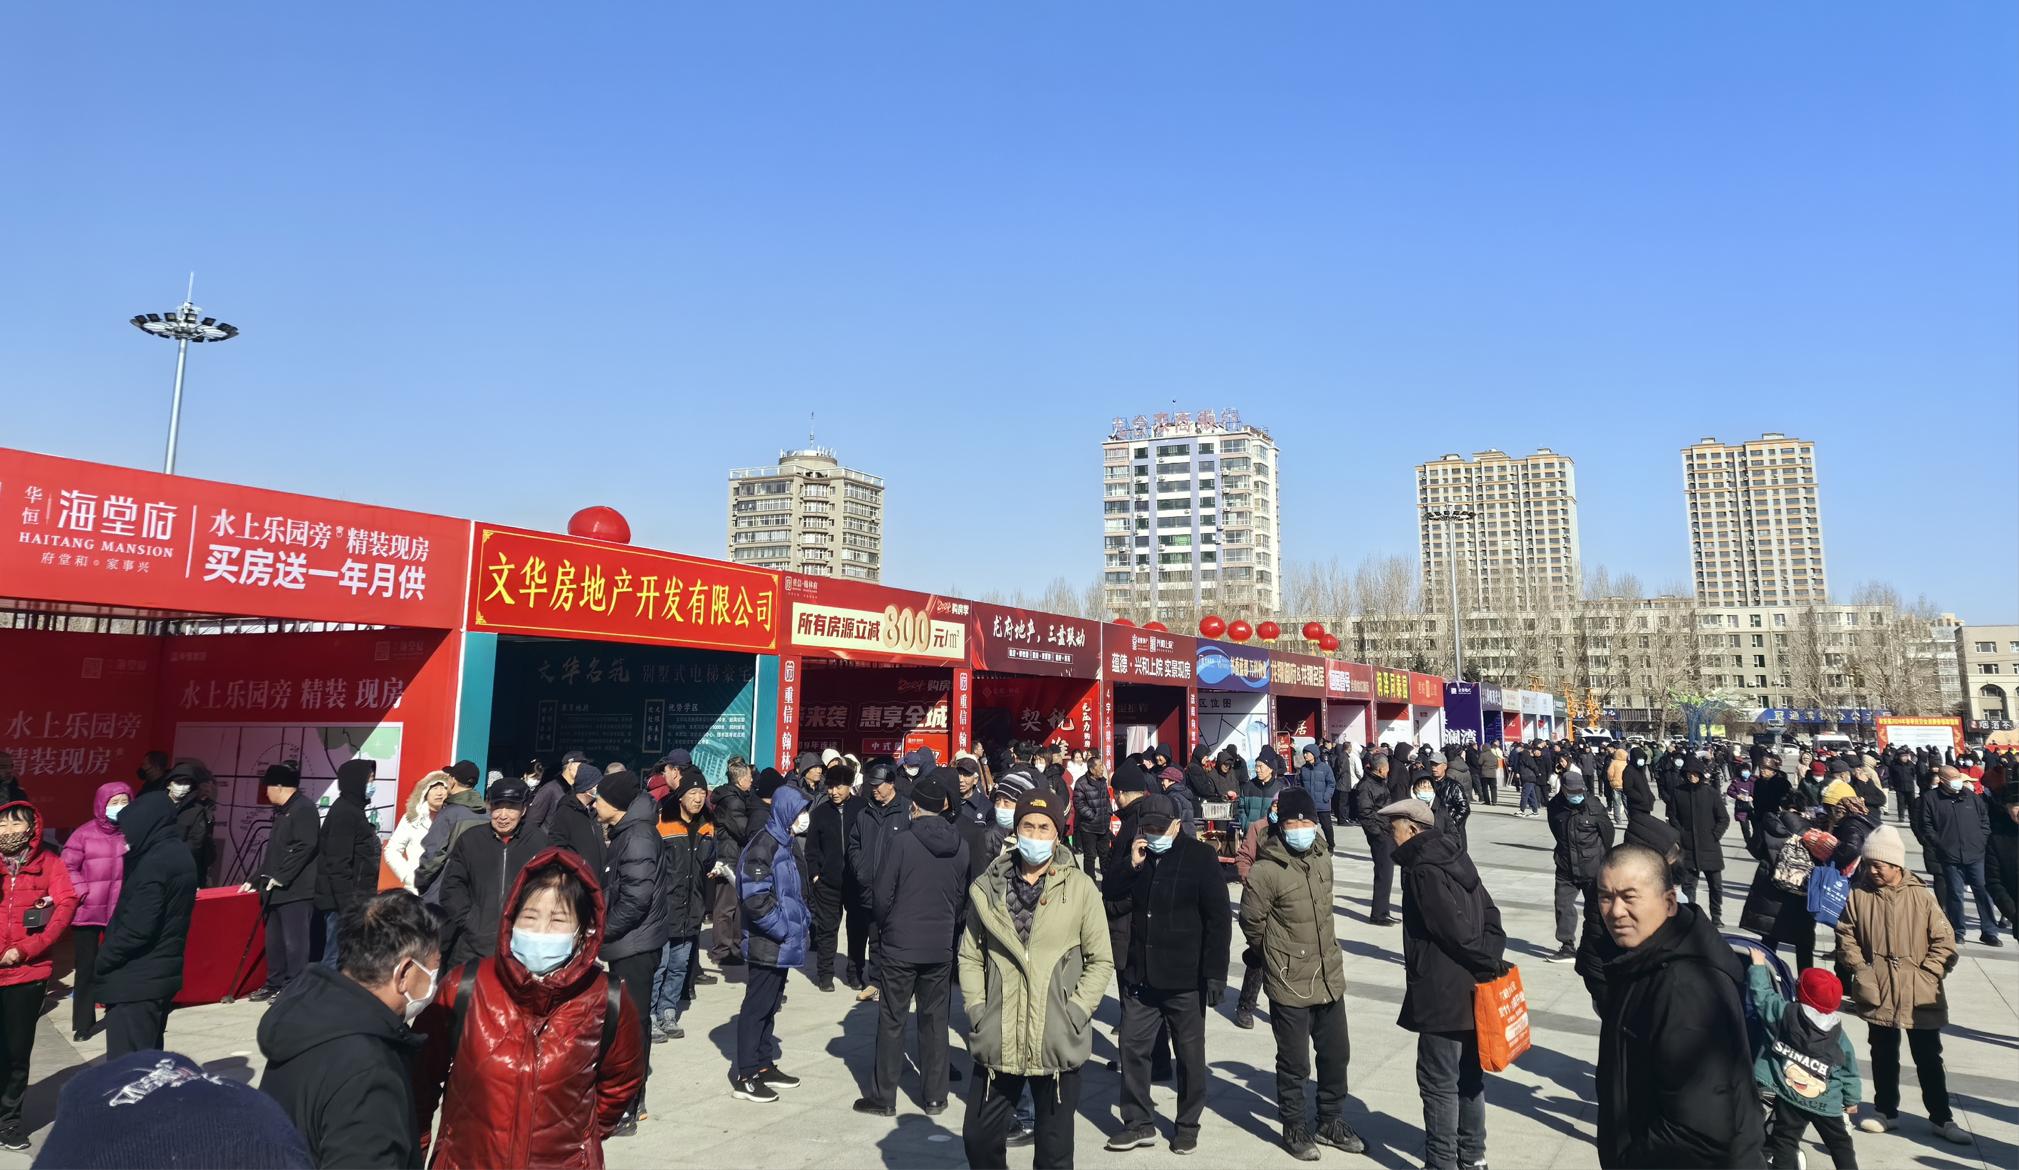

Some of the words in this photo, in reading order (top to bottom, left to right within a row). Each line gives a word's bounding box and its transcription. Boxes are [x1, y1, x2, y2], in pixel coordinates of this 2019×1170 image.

[57, 489, 178, 540] 海堂府
[209, 508, 333, 549] 水上乐园旁
[346, 527, 430, 561] 精装现房
[19, 531, 96, 550] HAITANG
[100, 540, 175, 558] MANSION
[202, 543, 426, 600] 买房送一年月供
[484, 551, 773, 632] 文华房地产开发有限公司
[179, 678, 293, 711] 水上乐园旁
[299, 676, 349, 710] 精装
[354, 676, 405, 710] 现房
[859, 704, 949, 729] 惠享全城
[6, 710, 145, 741] 水上乐园旁
[781, 686, 794, 777] 重信·翰林
